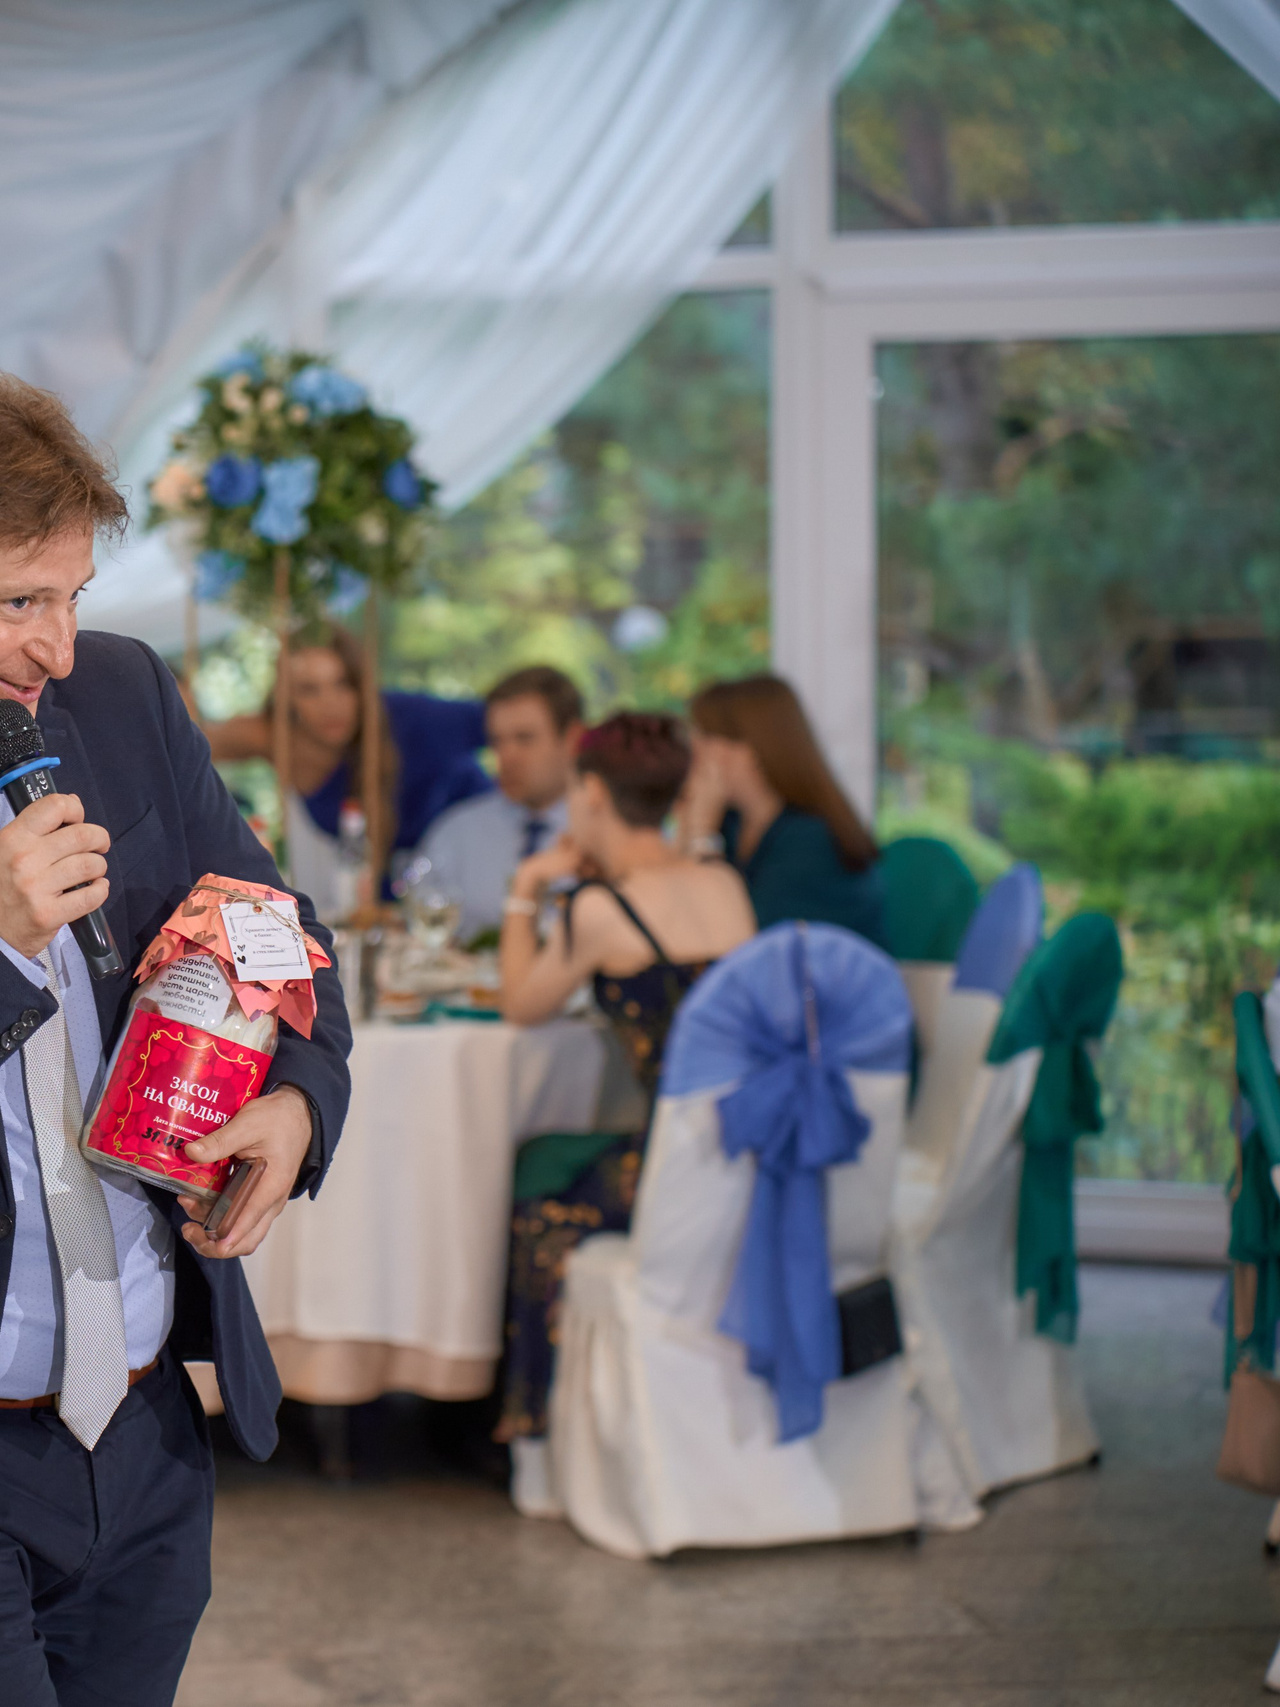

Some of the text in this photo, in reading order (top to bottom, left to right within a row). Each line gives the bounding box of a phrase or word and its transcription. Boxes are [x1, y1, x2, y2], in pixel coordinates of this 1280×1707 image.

[167, 964, 221, 983] счастливы,
[158, 980, 219, 1001] пусть царят
[162, 990, 195, 1003] любовь
[169, 1076, 220, 1104] ЗАСОЛ
[143, 1086, 231, 1126] НА СВАДЬБУ
[153, 1116, 169, 1126] Дата
